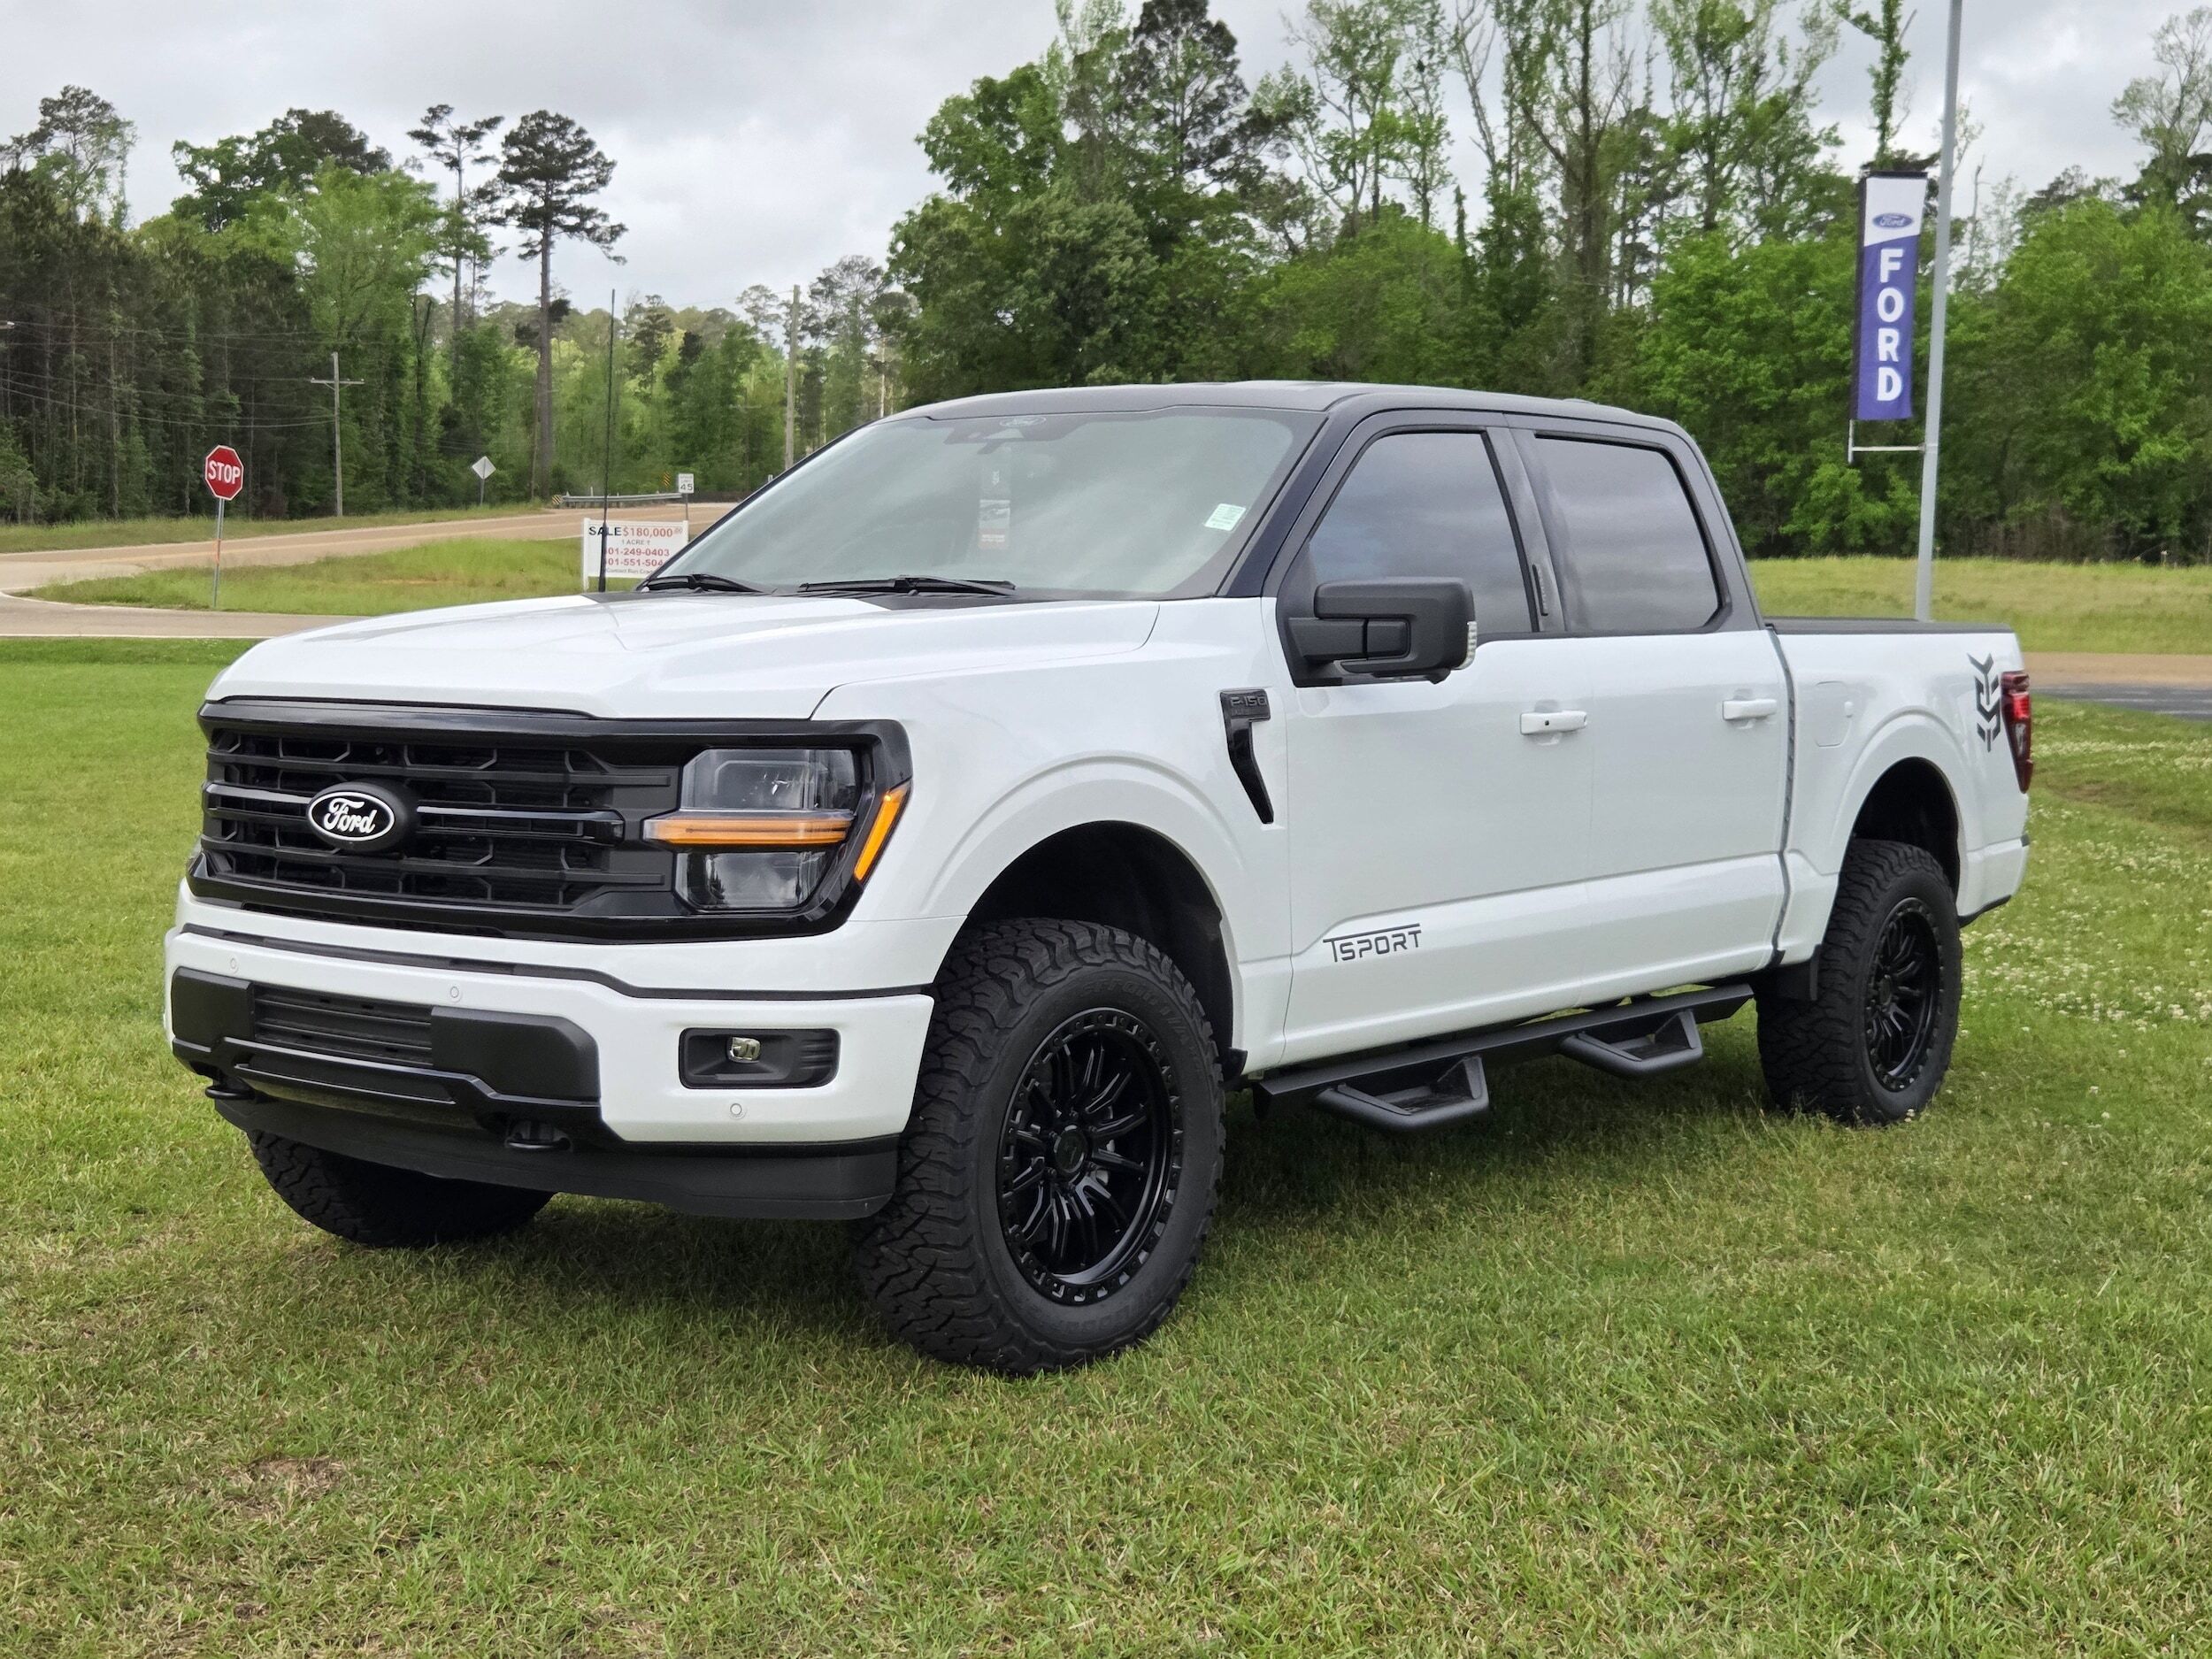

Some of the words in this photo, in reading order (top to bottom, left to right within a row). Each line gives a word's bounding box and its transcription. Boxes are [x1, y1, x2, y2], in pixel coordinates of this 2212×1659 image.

[1878, 214, 1908, 228] Ford
[1877, 248, 1905, 402] FORD
[208, 460, 241, 484] STOP
[588, 526, 622, 536] SALE
[622, 526, 673, 538] $180,000
[606, 547, 671, 557] 01-249-0403
[1230, 695, 1268, 708] F-150
[323, 797, 378, 833] Ford
